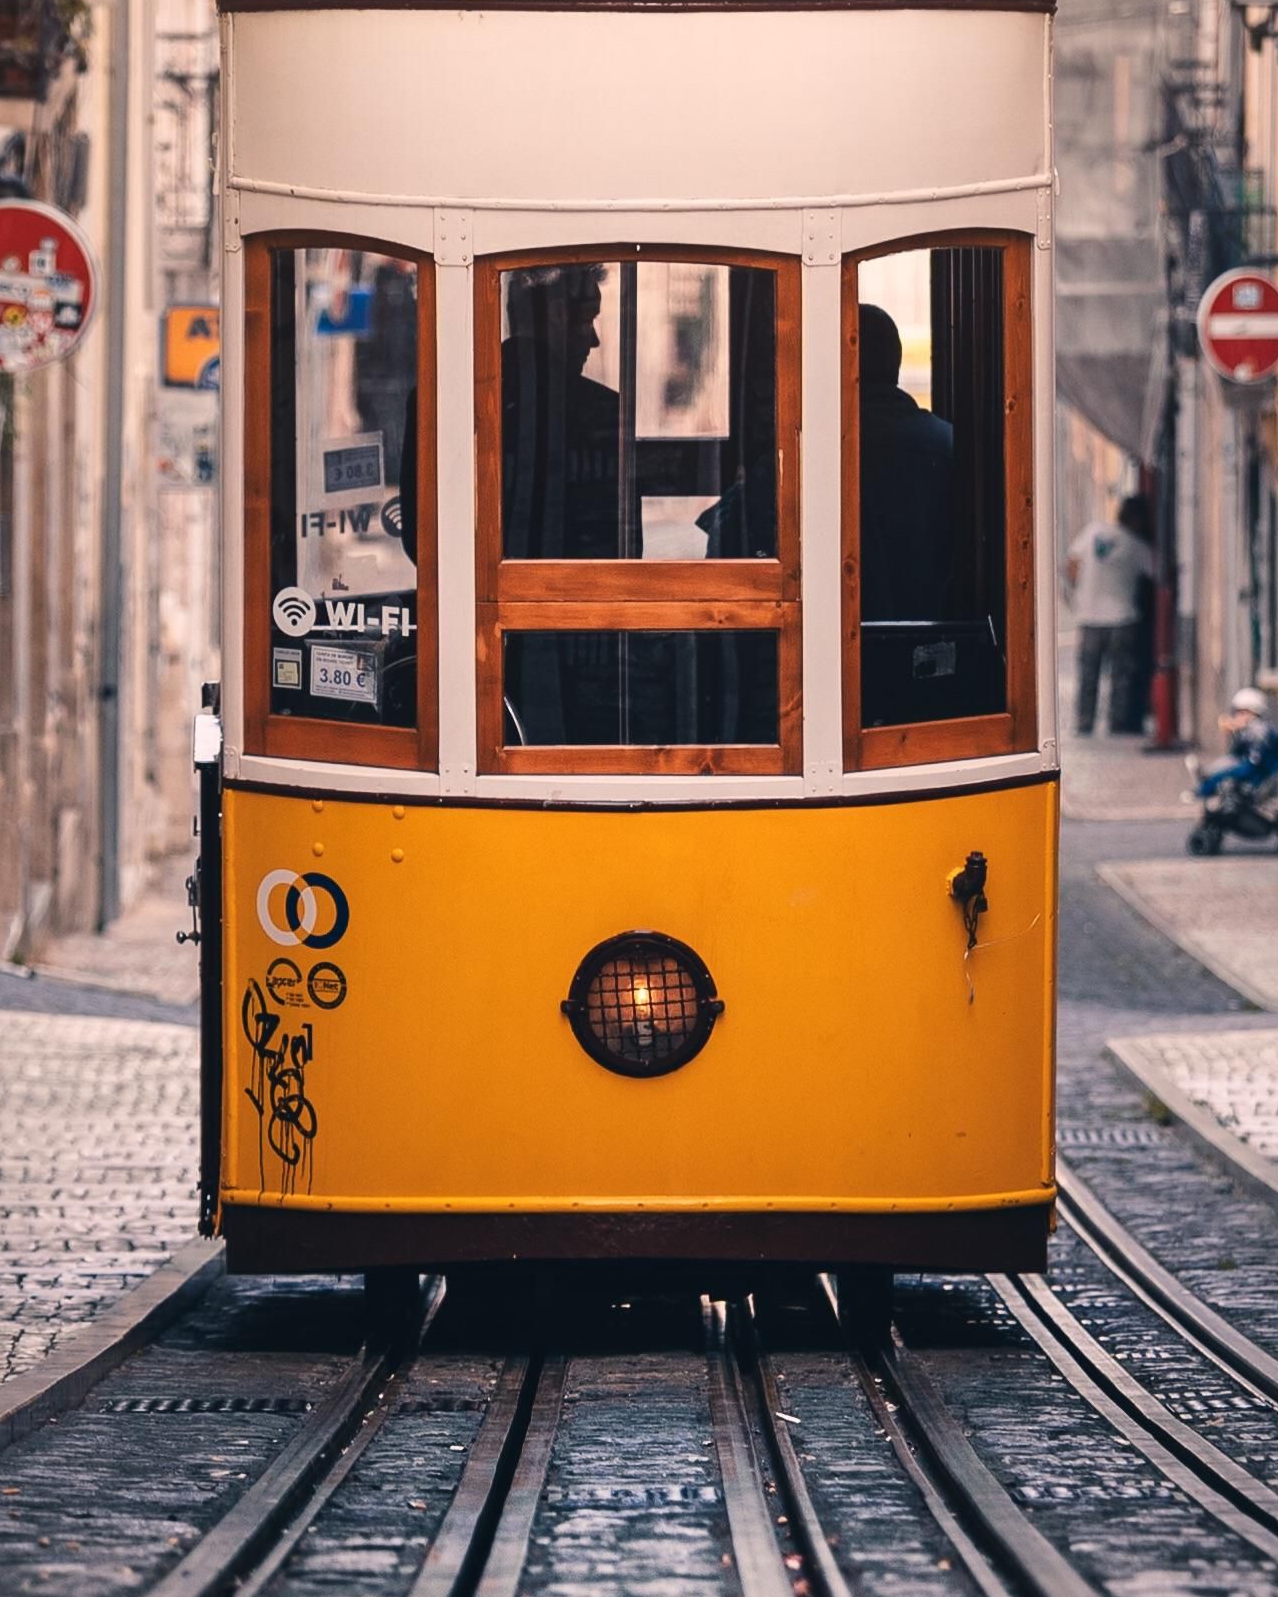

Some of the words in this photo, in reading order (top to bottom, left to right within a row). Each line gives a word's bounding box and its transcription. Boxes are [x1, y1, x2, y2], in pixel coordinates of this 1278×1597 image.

[324, 600, 410, 637] WI-FI
[320, 668, 351, 685] 3.80
[356, 672, 366, 688] €
